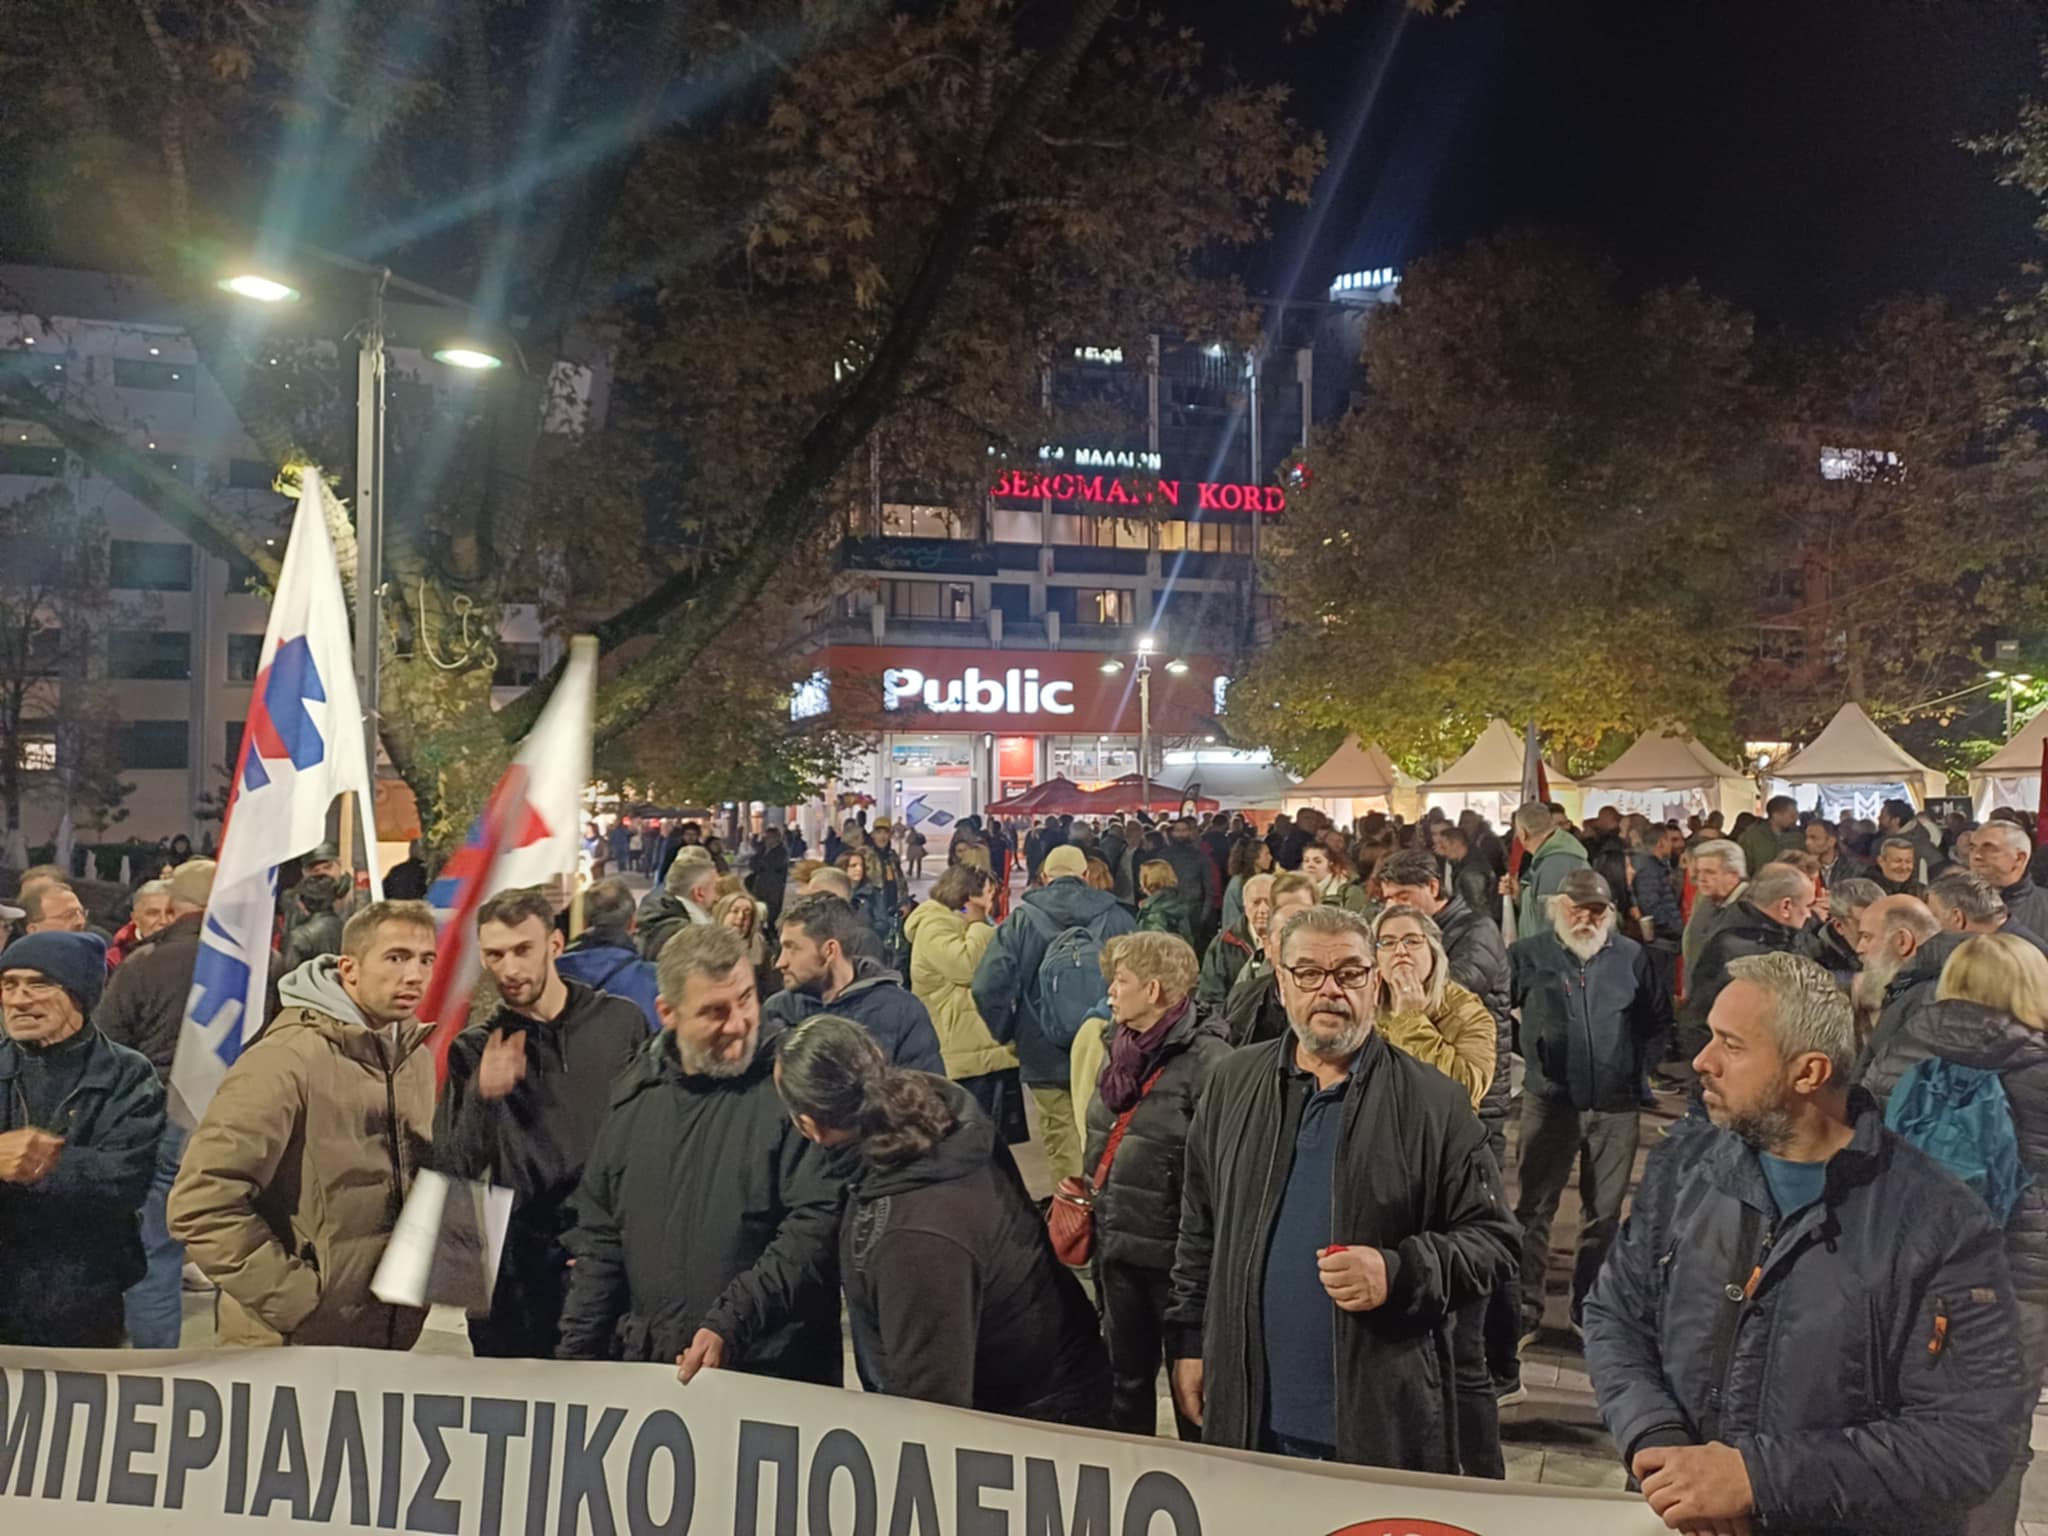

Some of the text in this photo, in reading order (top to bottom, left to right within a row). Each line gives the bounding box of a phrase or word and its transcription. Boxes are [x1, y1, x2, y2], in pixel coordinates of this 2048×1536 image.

[989, 469, 1285, 513] BERGMAN KORD
[884, 667, 1075, 714] Public
